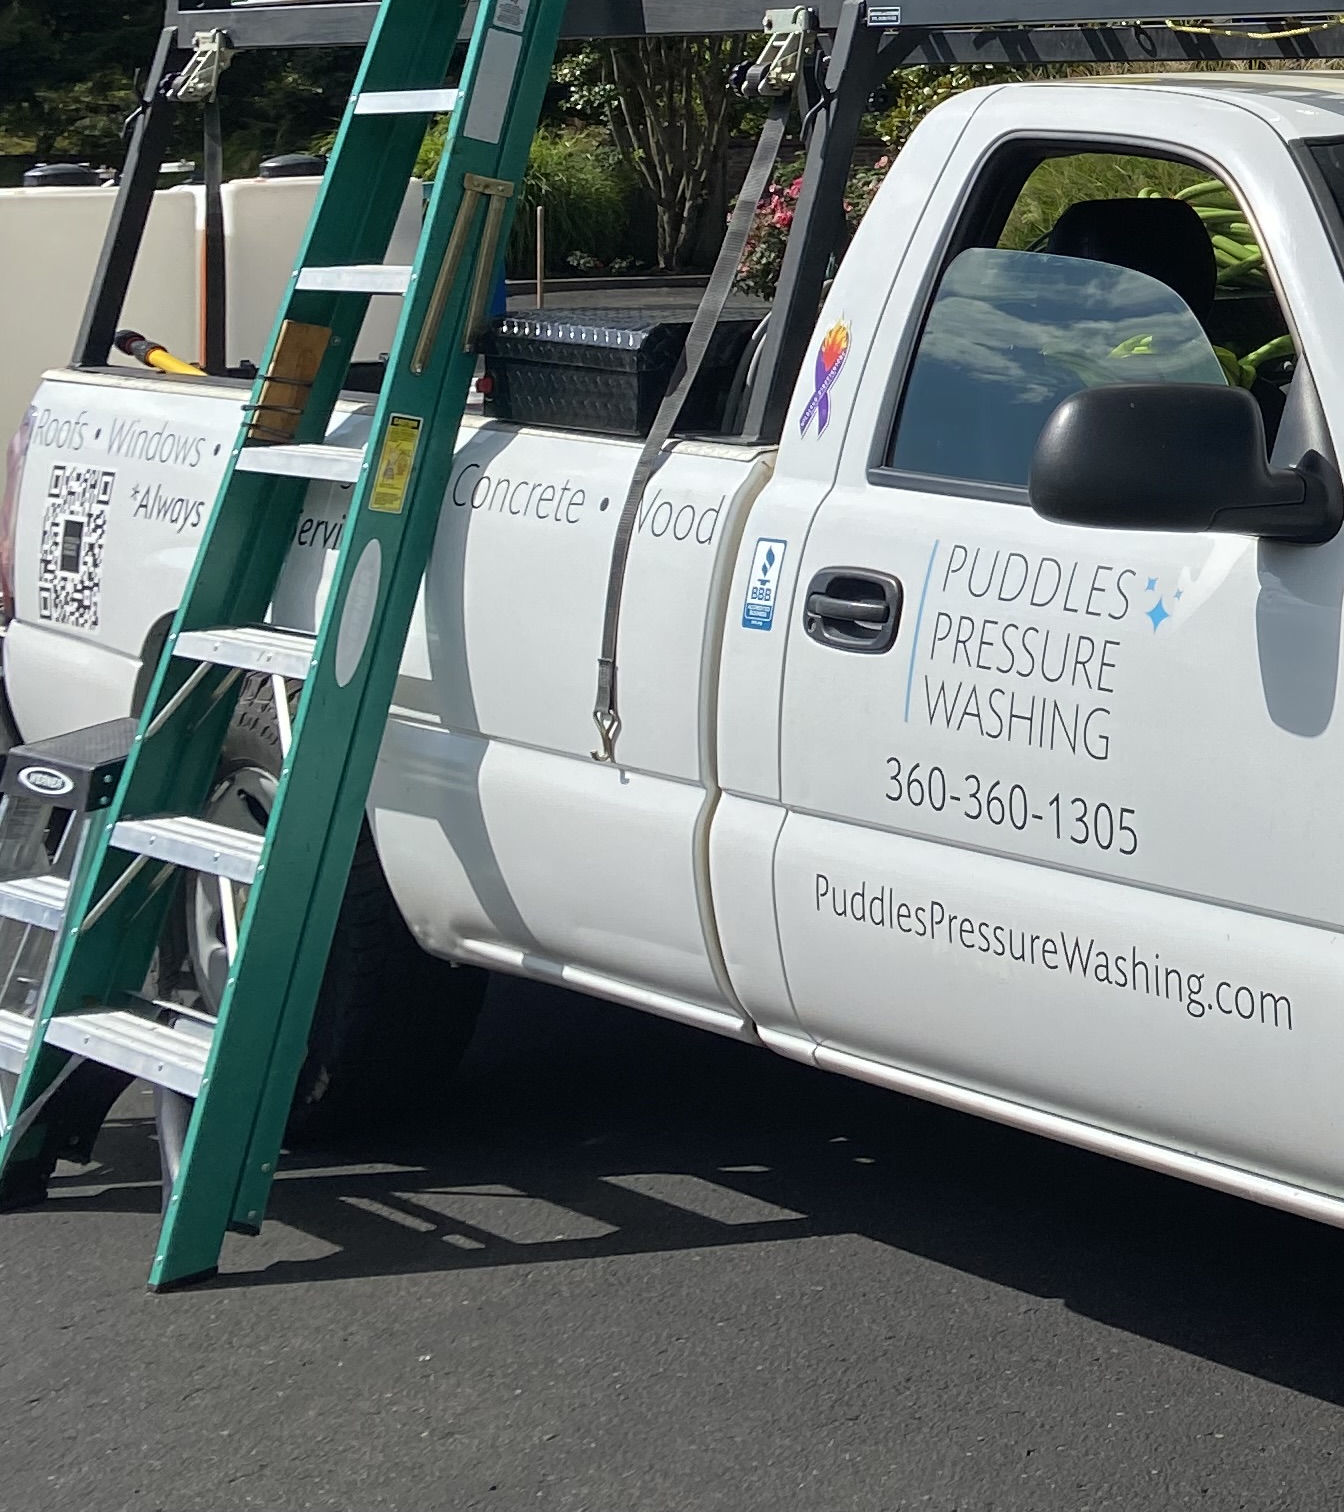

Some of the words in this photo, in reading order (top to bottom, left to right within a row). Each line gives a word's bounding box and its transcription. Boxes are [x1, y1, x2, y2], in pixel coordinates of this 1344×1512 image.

[33, 408, 89, 451] Roofs
[106, 417, 207, 468] Windows
[452, 462, 586, 524] Concrete
[293, 509, 347, 550] ervi
[750, 586, 772, 602] BBB
[942, 544, 1138, 620] PUDDLES
[930, 611, 1121, 693] PRESSURE
[924, 674, 1111, 761] WASHING
[885, 756, 1139, 856] 360-360-1305
[815, 873, 1294, 1031] PuddlesPressureWashing.com
